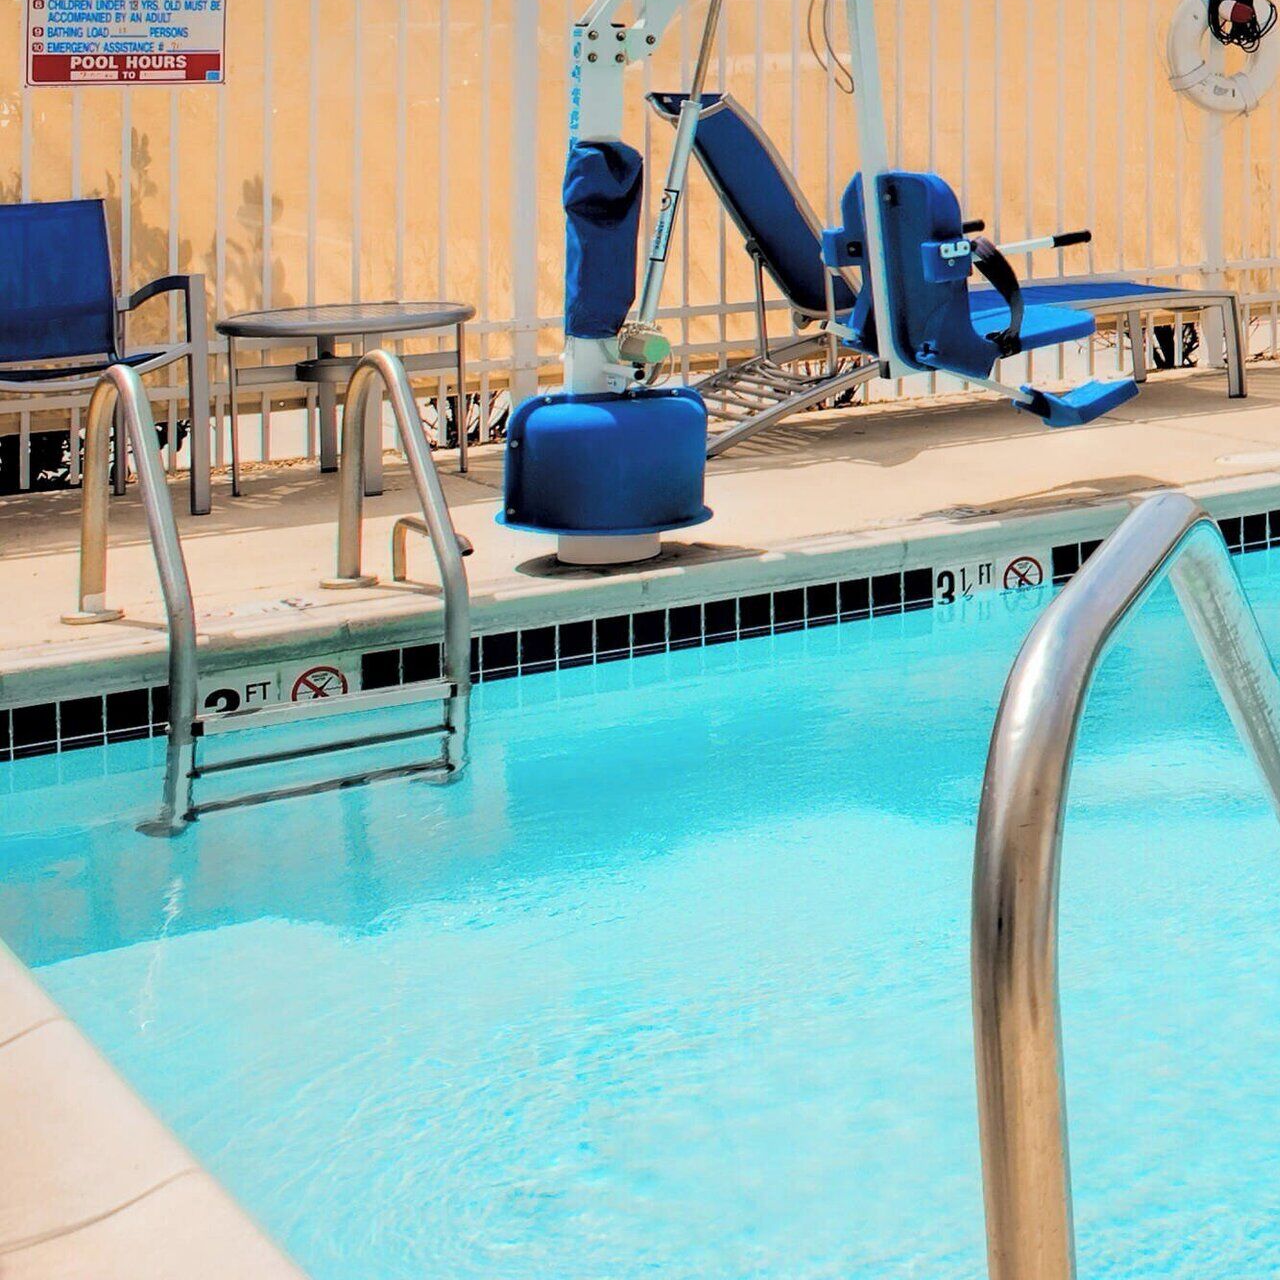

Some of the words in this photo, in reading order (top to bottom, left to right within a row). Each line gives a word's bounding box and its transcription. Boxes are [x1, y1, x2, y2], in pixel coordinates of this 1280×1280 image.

[48, 0, 92, 10] CHILDREN
[96, 0, 125, 10] UNDER
[163, 1, 181, 11] OLD
[184, 1, 207, 11] MUST
[210, 1, 221, 11] BE
[48, 12, 112, 23] ACCOMPANIED
[115, 13, 126, 23] BY
[130, 13, 142, 23] AN
[146, 13, 172, 23] ADULT
[47, 27, 83, 38] BATHING
[87, 27, 109, 38] LOAD
[149, 27, 189, 38] PERSONS
[47, 41, 99, 52] EMERGENCY
[103, 41, 154, 52] ASSISTANCE
[70, 55, 118, 69] POOL
[126, 55, 187, 69] HOURS
[122, 71, 136, 79] TO
[937, 570, 955, 605] 3
[979, 562, 992, 585] FT
[246, 681, 271, 703] FT
